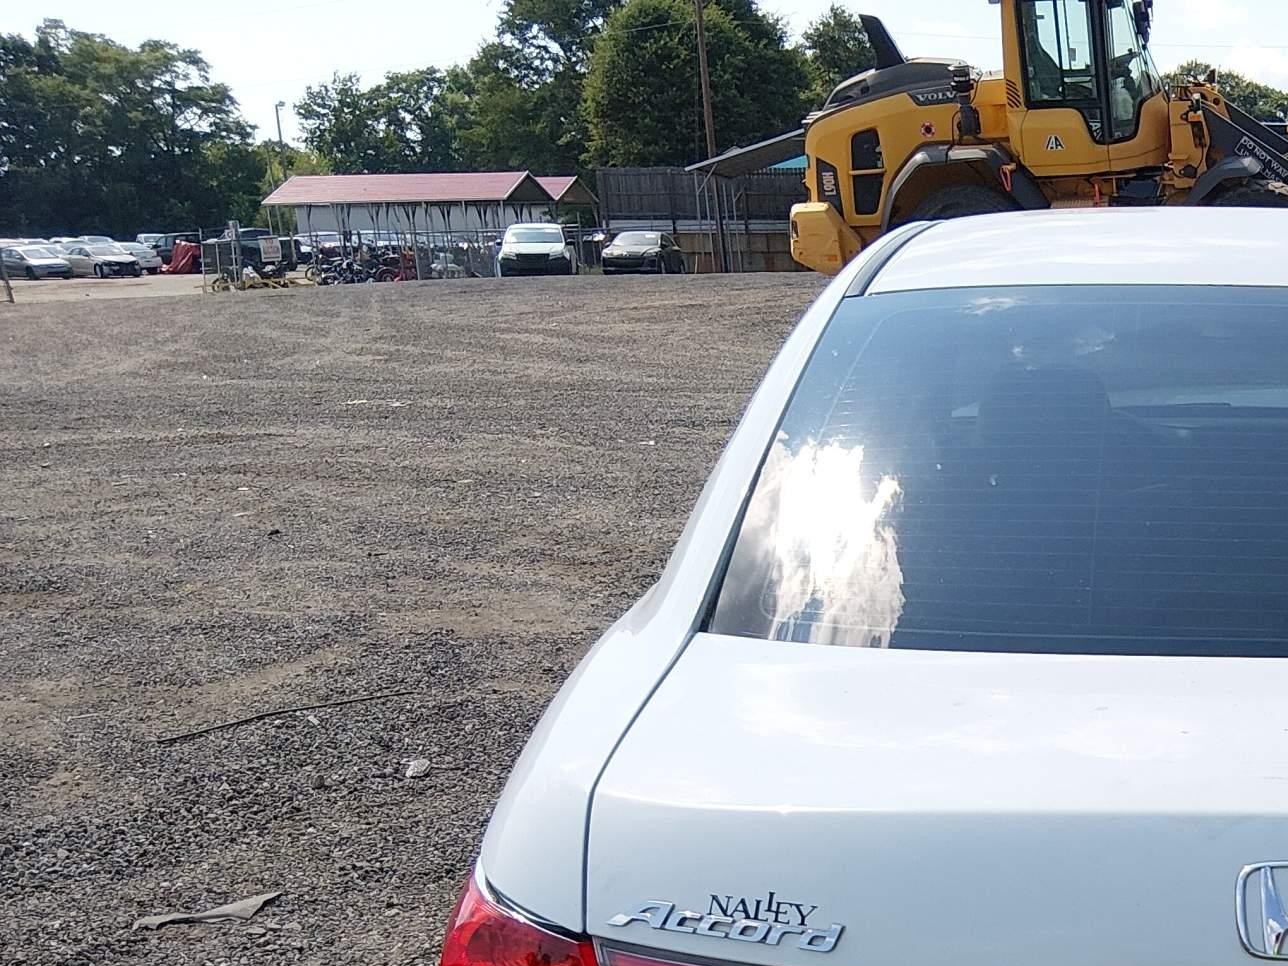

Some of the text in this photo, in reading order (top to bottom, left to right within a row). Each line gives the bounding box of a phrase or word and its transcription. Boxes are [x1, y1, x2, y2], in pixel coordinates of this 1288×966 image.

[915, 91, 959, 101] VOLV
[607, 899, 847, 953] Accord
[706, 891, 818, 926] NALLEY
